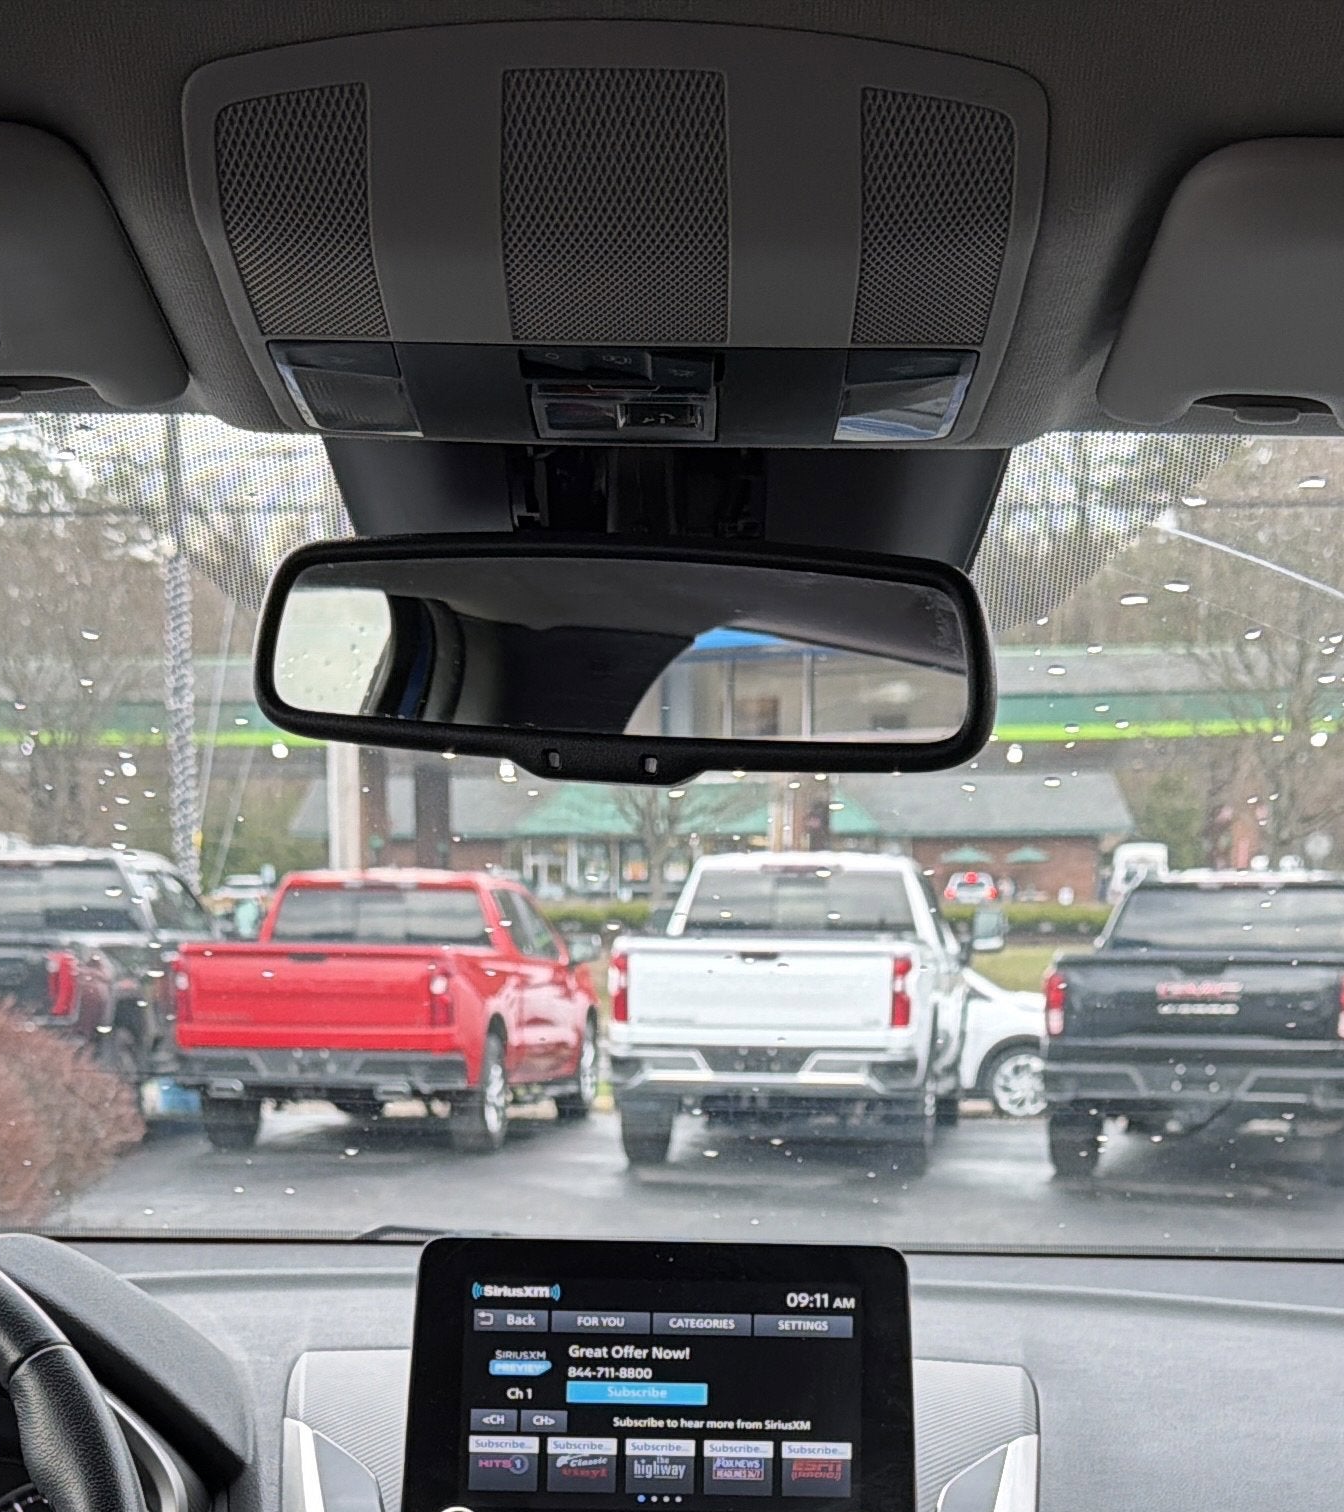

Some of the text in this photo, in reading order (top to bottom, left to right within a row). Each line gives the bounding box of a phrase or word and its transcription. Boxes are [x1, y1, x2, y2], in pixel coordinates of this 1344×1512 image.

[786, 1292, 856, 1309] 09:11 AM
[506, 1313, 537, 1327] Back
[576, 1315, 625, 1328] FOR YOU
[668, 1317, 736, 1330] CATEGORIES
[777, 1319, 829, 1332] SETTINGS
[567, 1345, 691, 1361] Great Offer Now!
[567, 1366, 653, 1379] 844-711-8800
[506, 1387, 533, 1400] Ch 1
[607, 1386, 668, 1398] Subscribe
[612, 1416, 811, 1431] Subscribe to hear more from SiriusXM
[478, 1459, 513, 1469] HITS
[633, 1459, 686, 1480] highway
